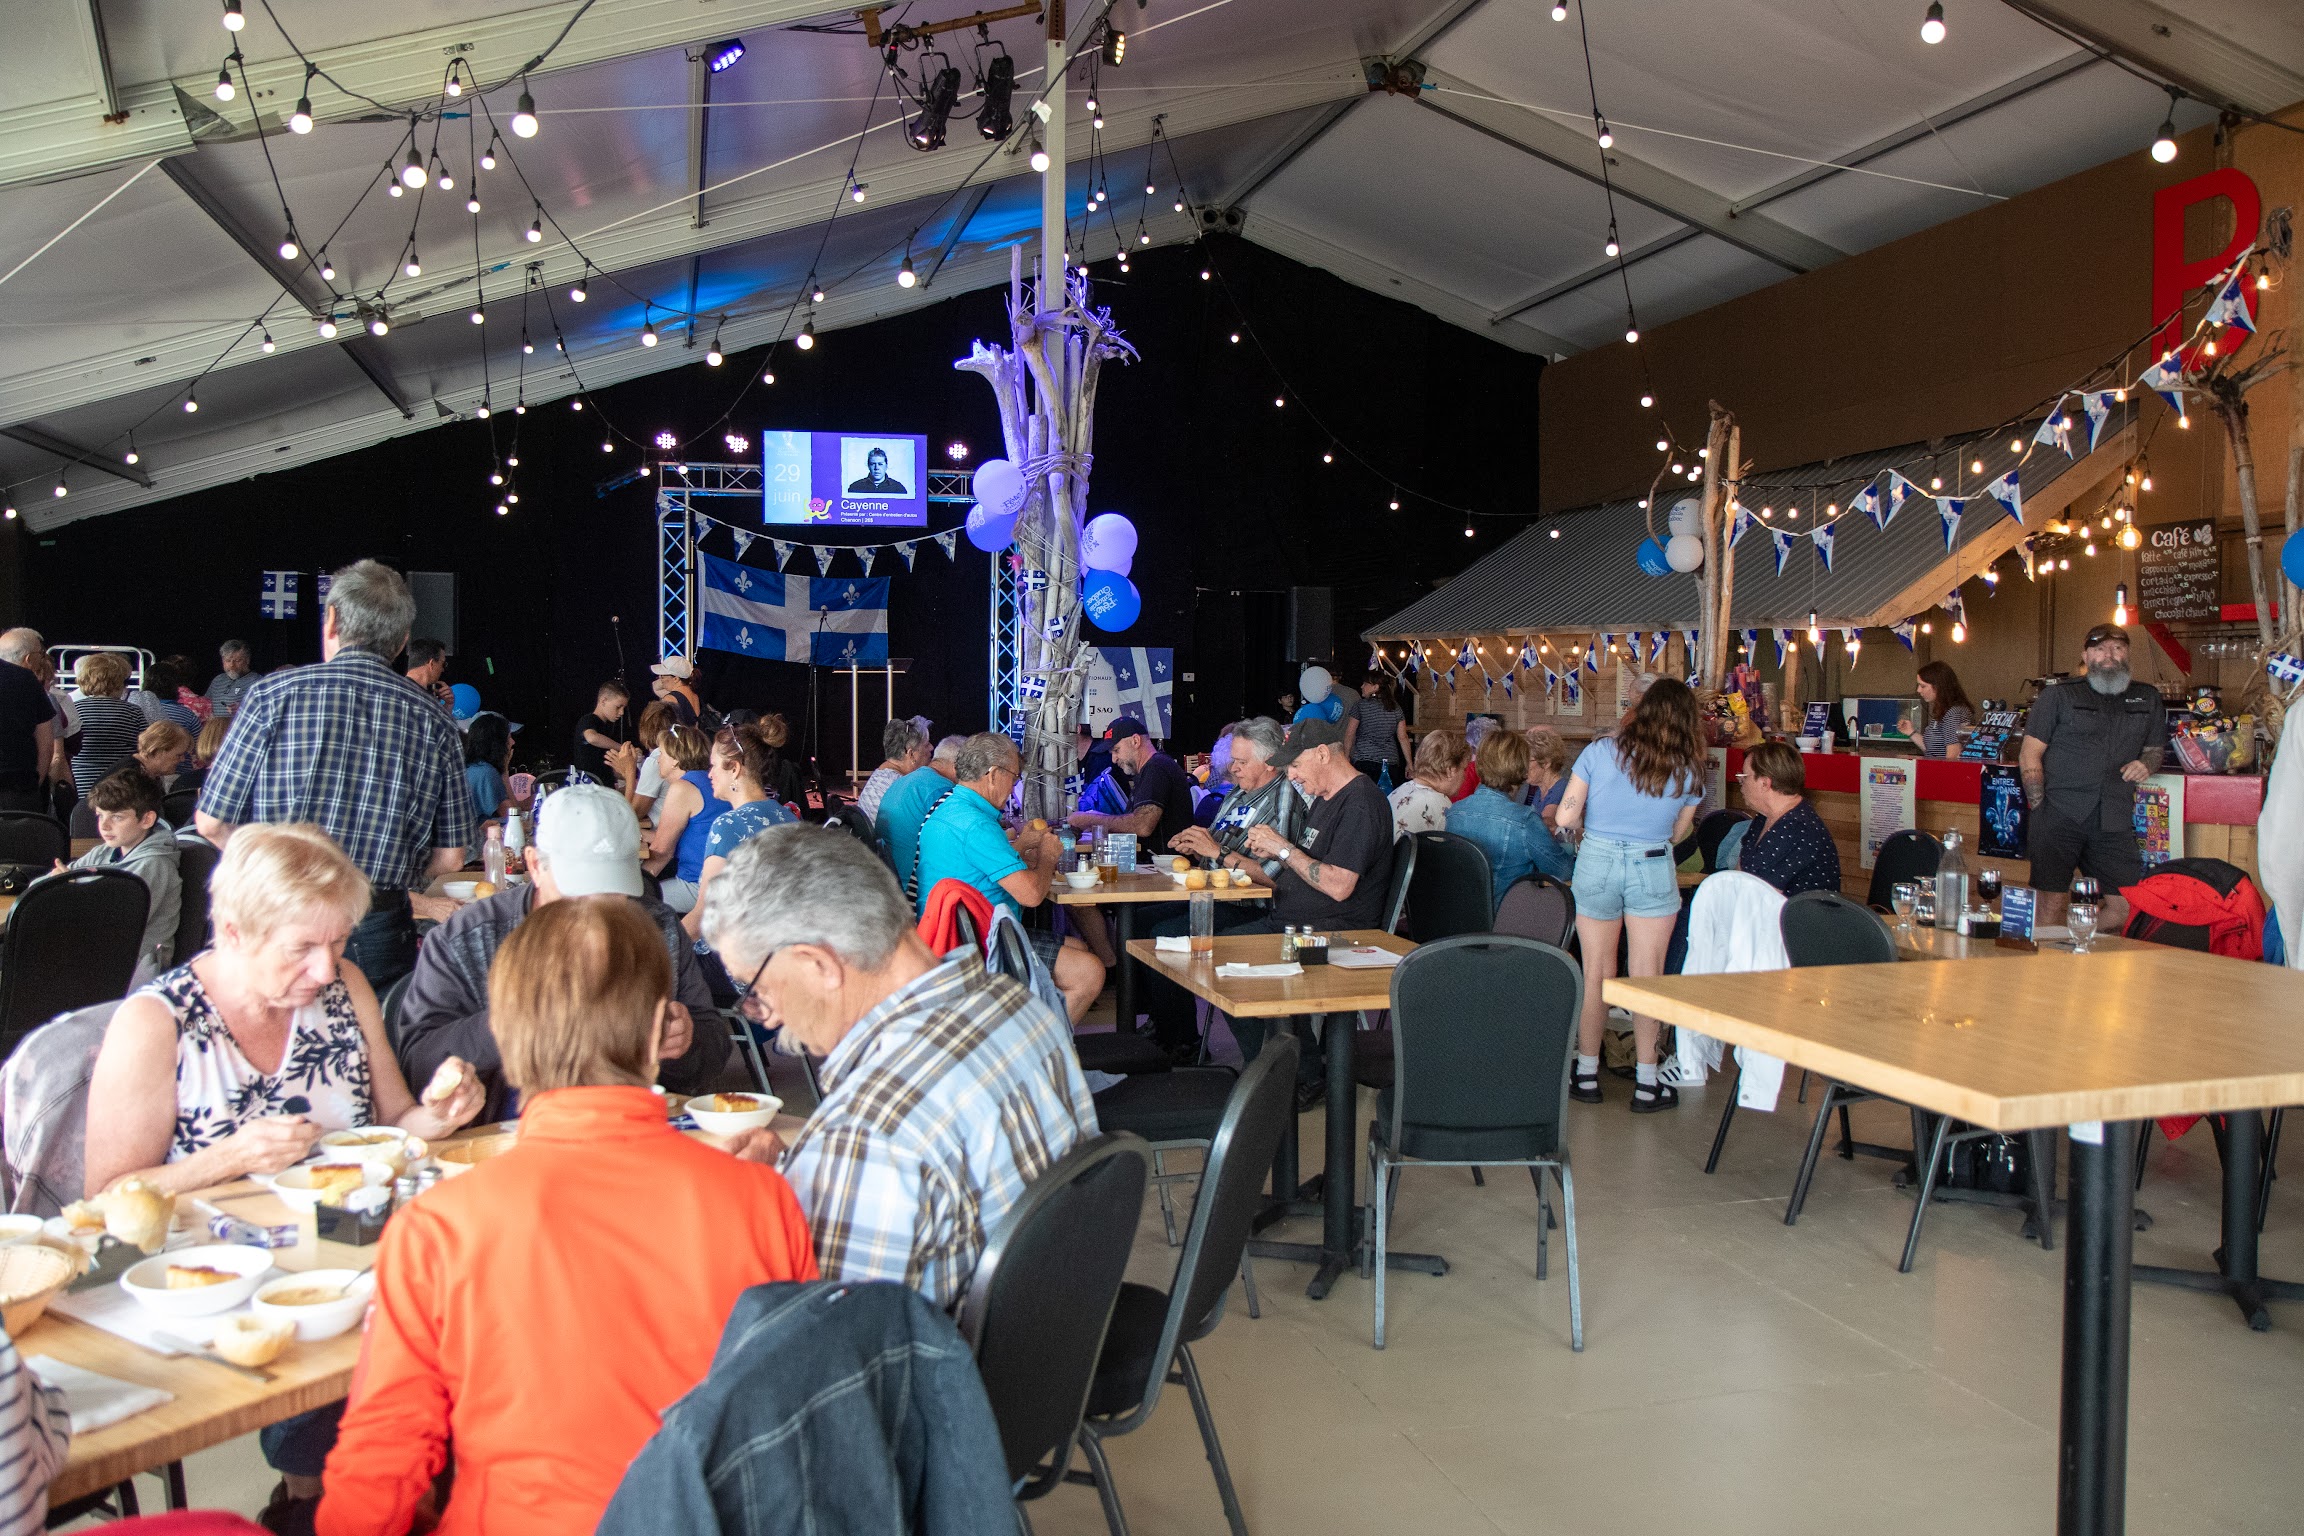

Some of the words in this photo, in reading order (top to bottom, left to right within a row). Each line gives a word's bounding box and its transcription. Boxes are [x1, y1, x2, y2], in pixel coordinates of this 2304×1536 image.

[775, 464, 800, 482] 29
[773, 489, 801, 506] juin
[841, 500, 889, 512] Cayenne
[2151, 527, 2190, 549] Café
[2141, 550, 2162, 563] latte
[2173, 548, 2187, 559] café
[2141, 563, 2179, 576] cappuccino
[2141, 575, 2174, 587] cortado
[2184, 573, 2213, 582] expresso
[2143, 585, 2181, 596] macchiato
[2143, 596, 2186, 608] americano
[2155, 608, 2184, 619] chocolat
[1982, 712, 2017, 727] SPECIAL
[1992, 777, 2015, 786] ENTREZ
[2000, 786, 2020, 795] DANSE
